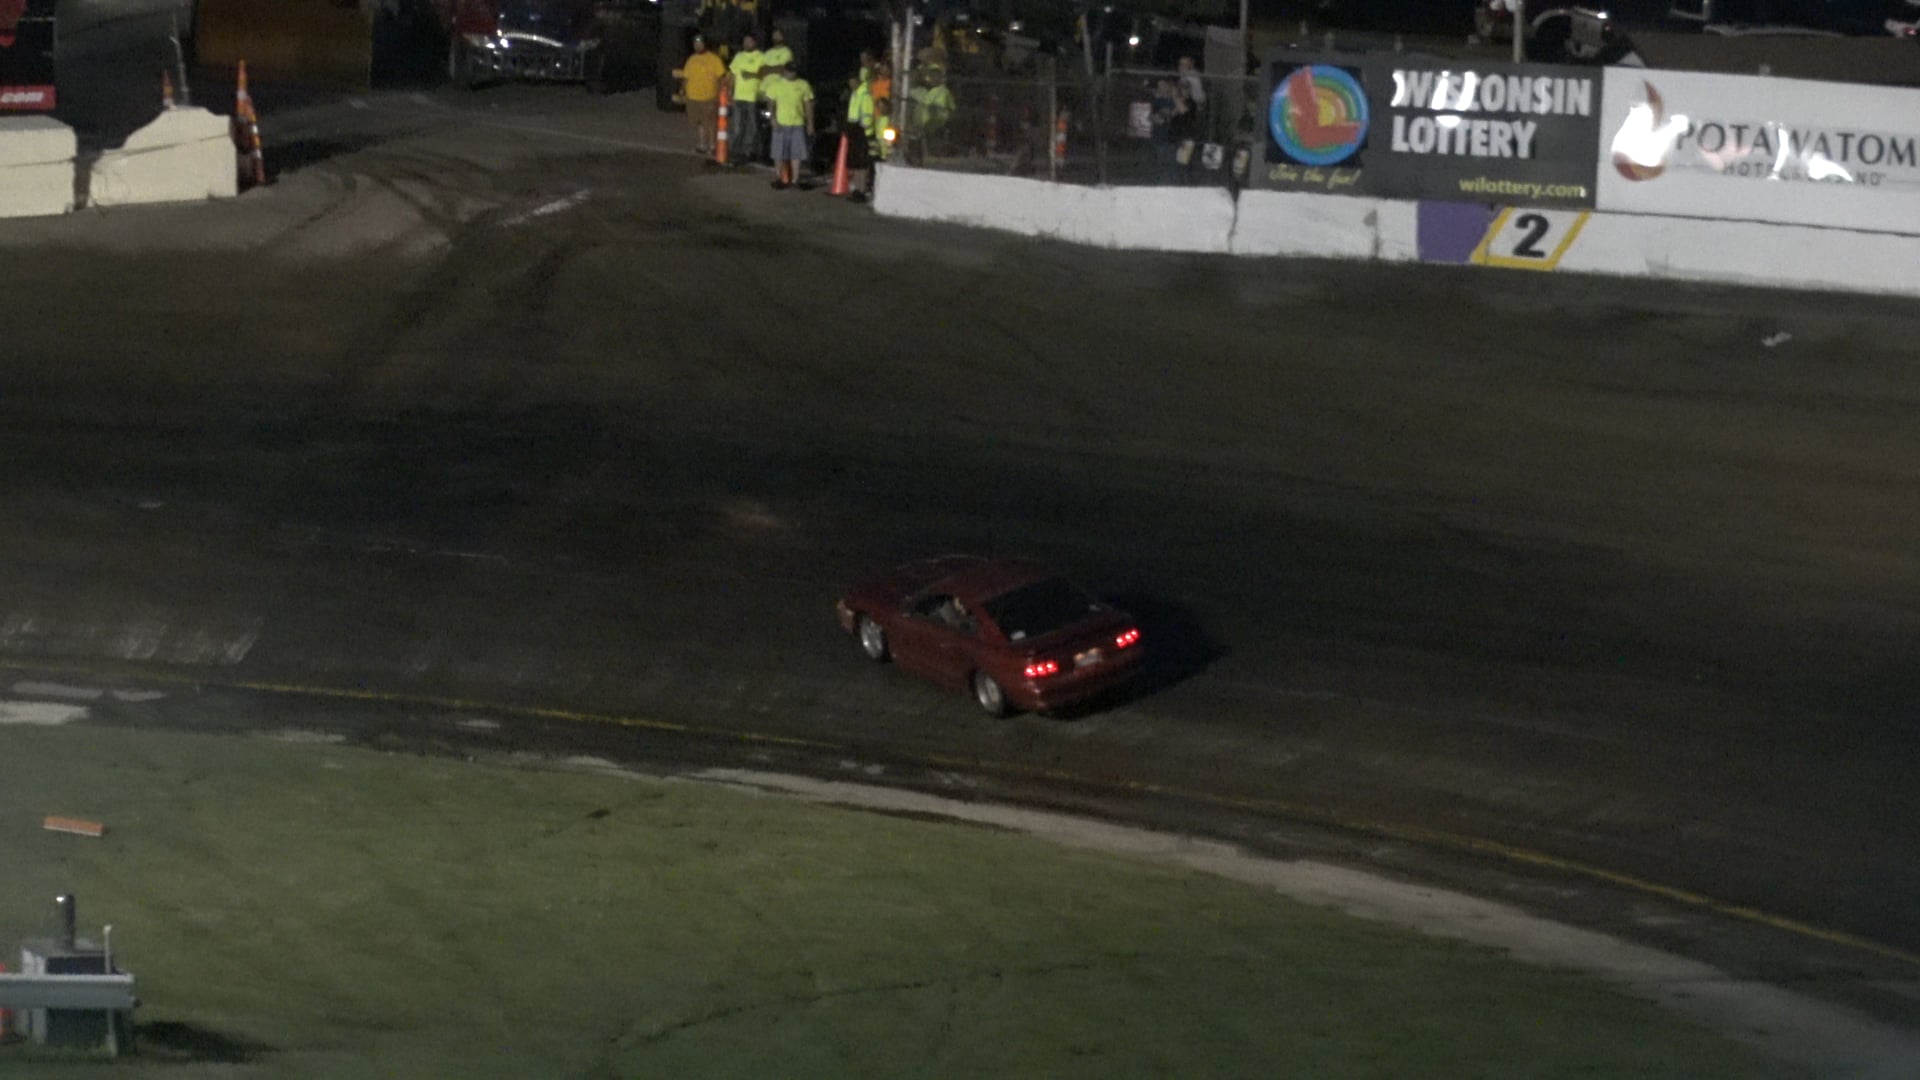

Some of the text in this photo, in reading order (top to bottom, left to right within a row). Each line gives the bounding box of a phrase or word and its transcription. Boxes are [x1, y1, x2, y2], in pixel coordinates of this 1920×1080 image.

[1391, 114, 1537, 159] LOTTERY
[1459, 177, 1587, 198] wilottery.com
[1512, 213, 1549, 258] 2
